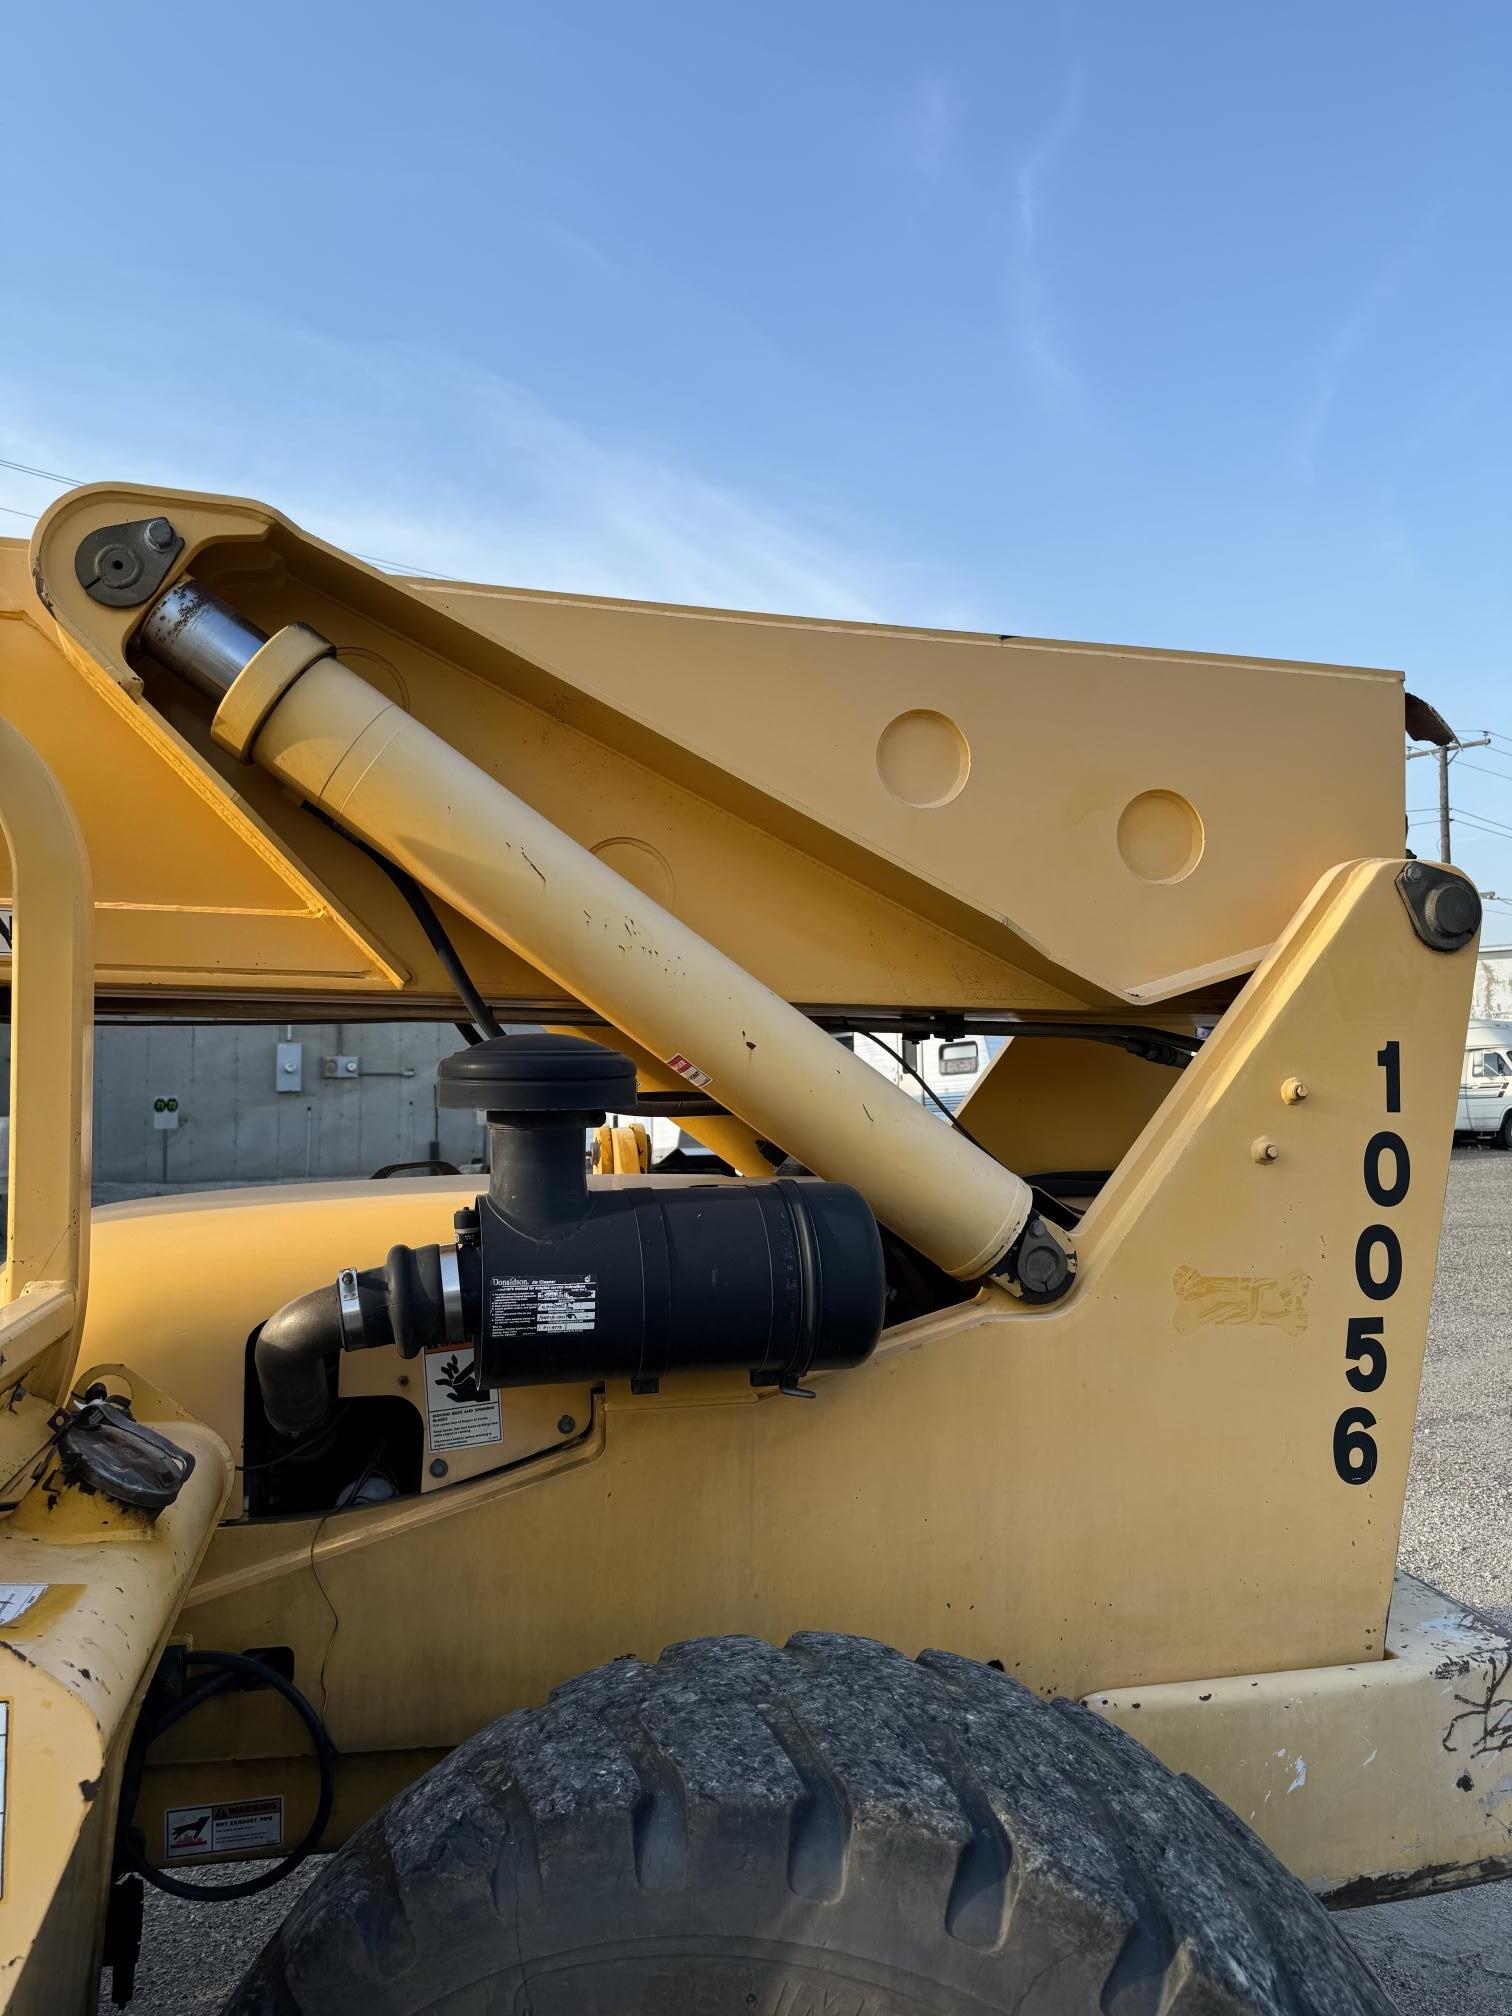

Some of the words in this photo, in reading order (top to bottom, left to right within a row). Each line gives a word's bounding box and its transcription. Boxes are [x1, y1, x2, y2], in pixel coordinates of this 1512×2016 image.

[475, 1405, 495, 1413] SPINNING
[229, 1801, 277, 1815] WARNING
[229, 1818, 258, 1827] EXHAUST
